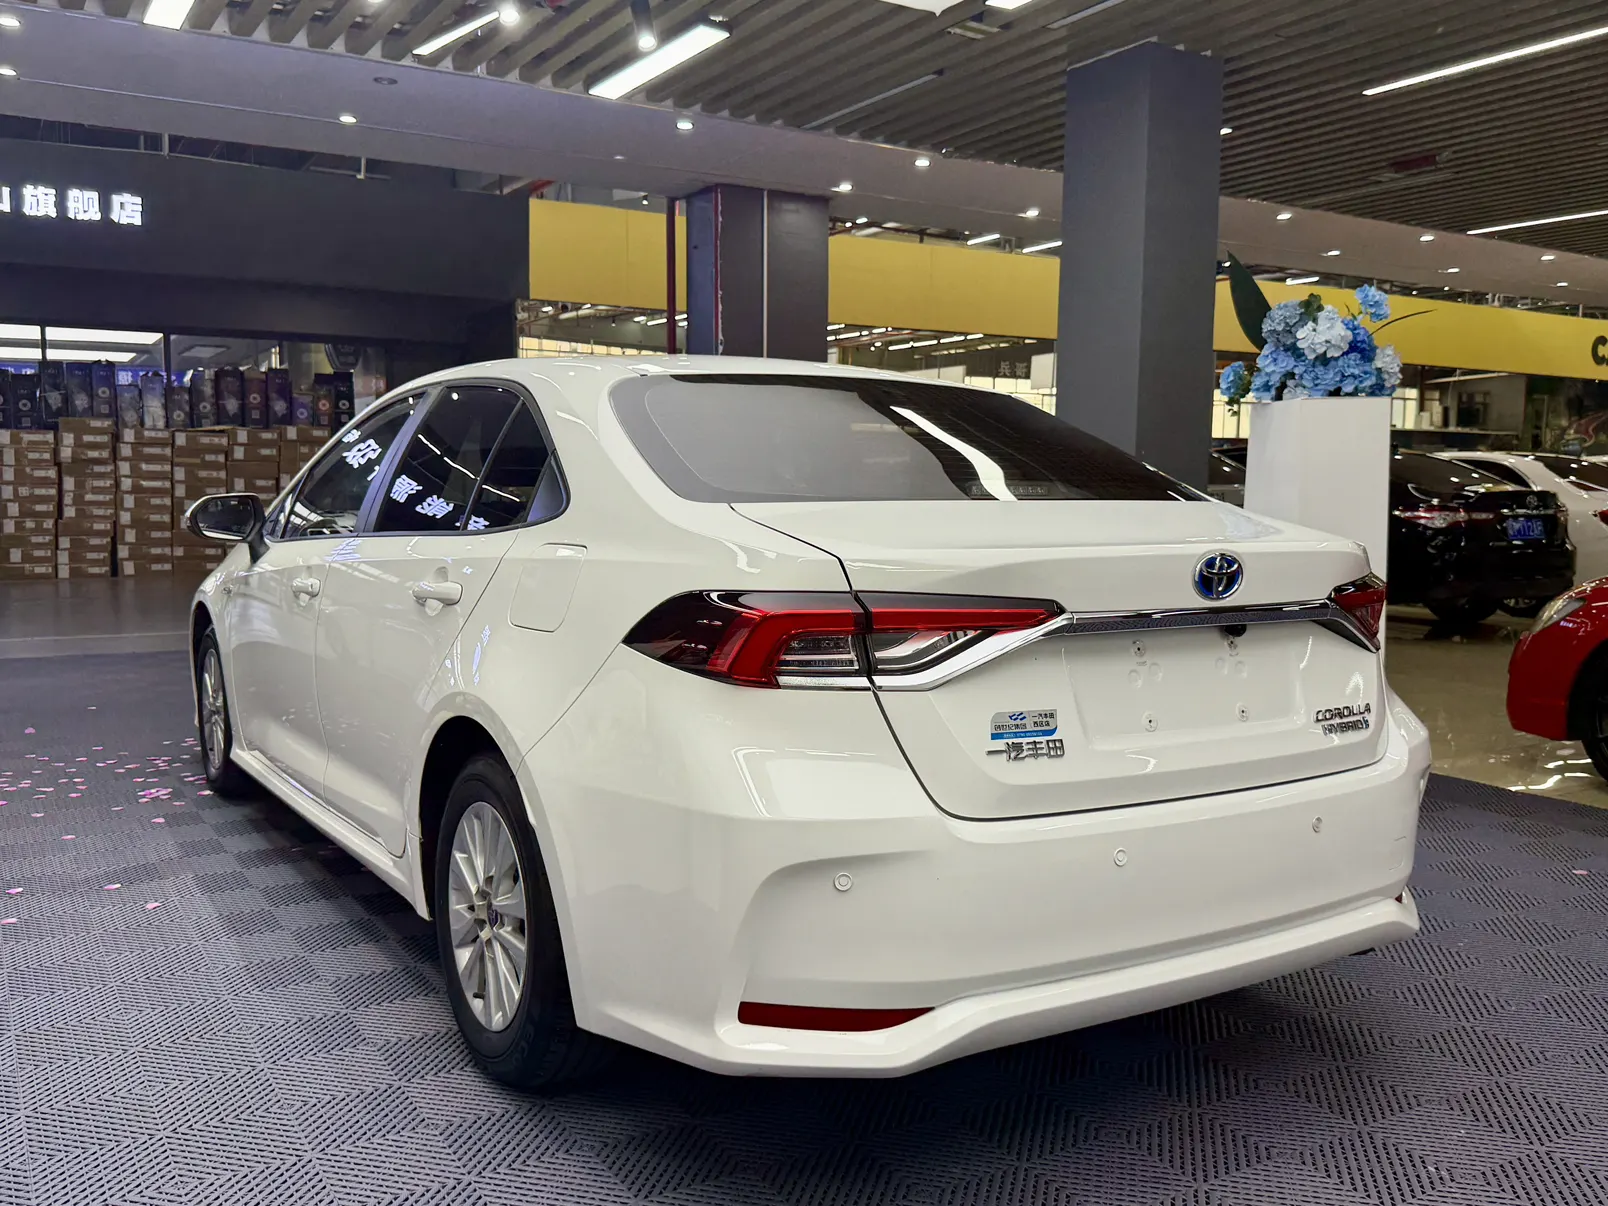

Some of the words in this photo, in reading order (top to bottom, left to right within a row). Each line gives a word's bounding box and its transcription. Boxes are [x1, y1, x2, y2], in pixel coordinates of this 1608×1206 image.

[1591, 335, 1608, 366] C
[1313, 703, 1371, 723] COROLLA
[985, 738, 1065, 761] 一汽丰田
